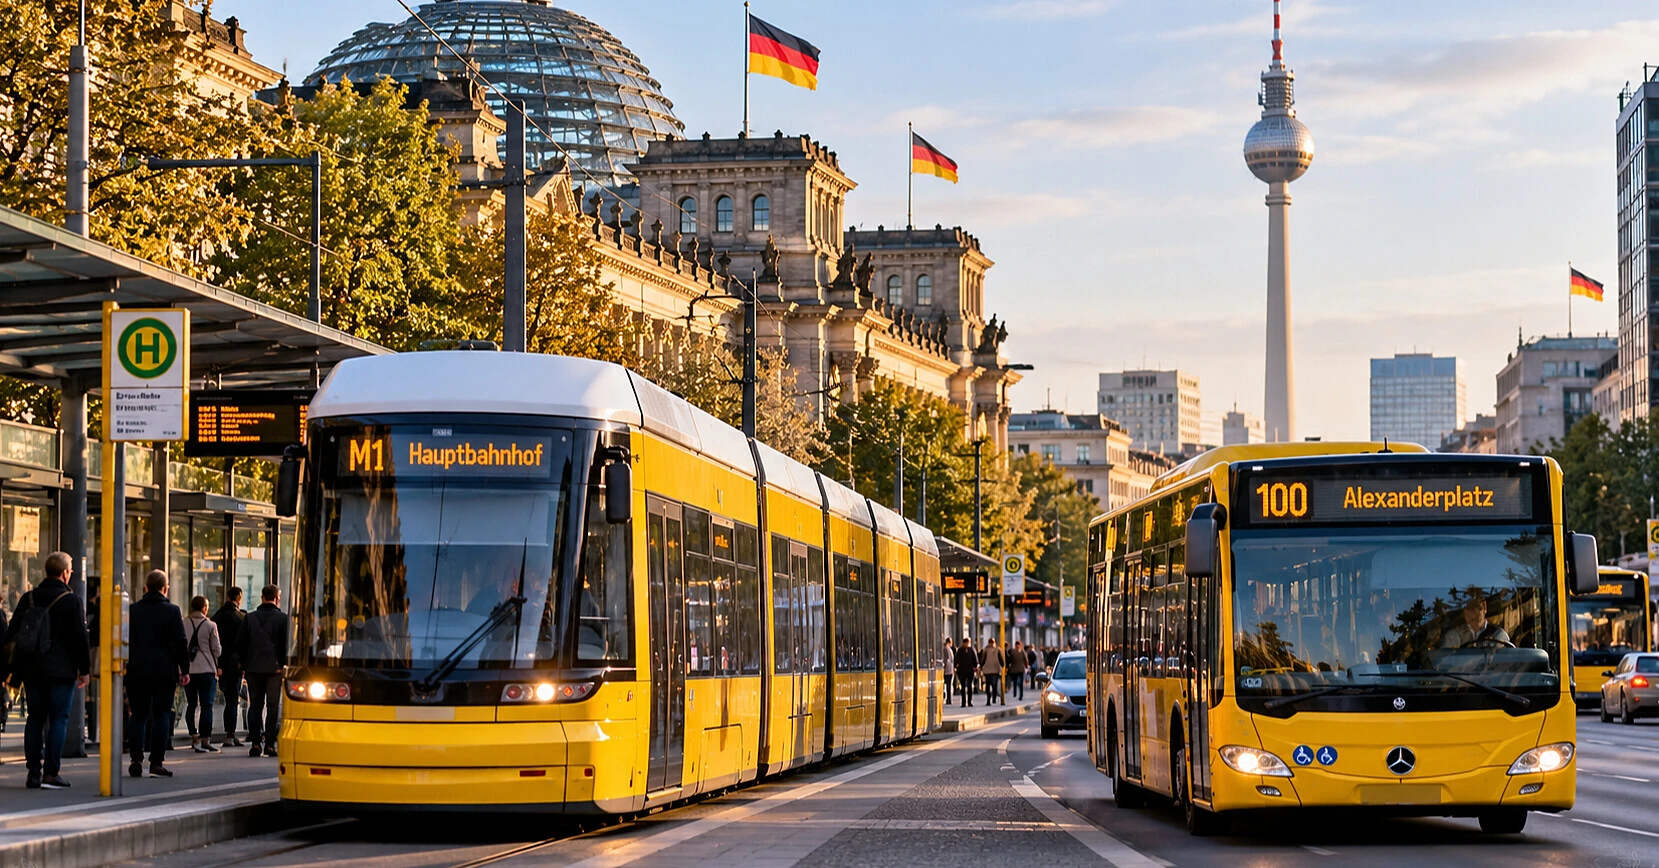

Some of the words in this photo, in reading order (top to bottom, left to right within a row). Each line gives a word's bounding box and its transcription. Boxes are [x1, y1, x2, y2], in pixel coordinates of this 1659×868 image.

[135, 333, 160, 364] H
[350, 439, 384, 472] M1
[409, 442, 543, 470] Hauptbahnhof
[1256, 482, 1308, 518] 100
[1343, 485, 1494, 512] Alexanderplatz
